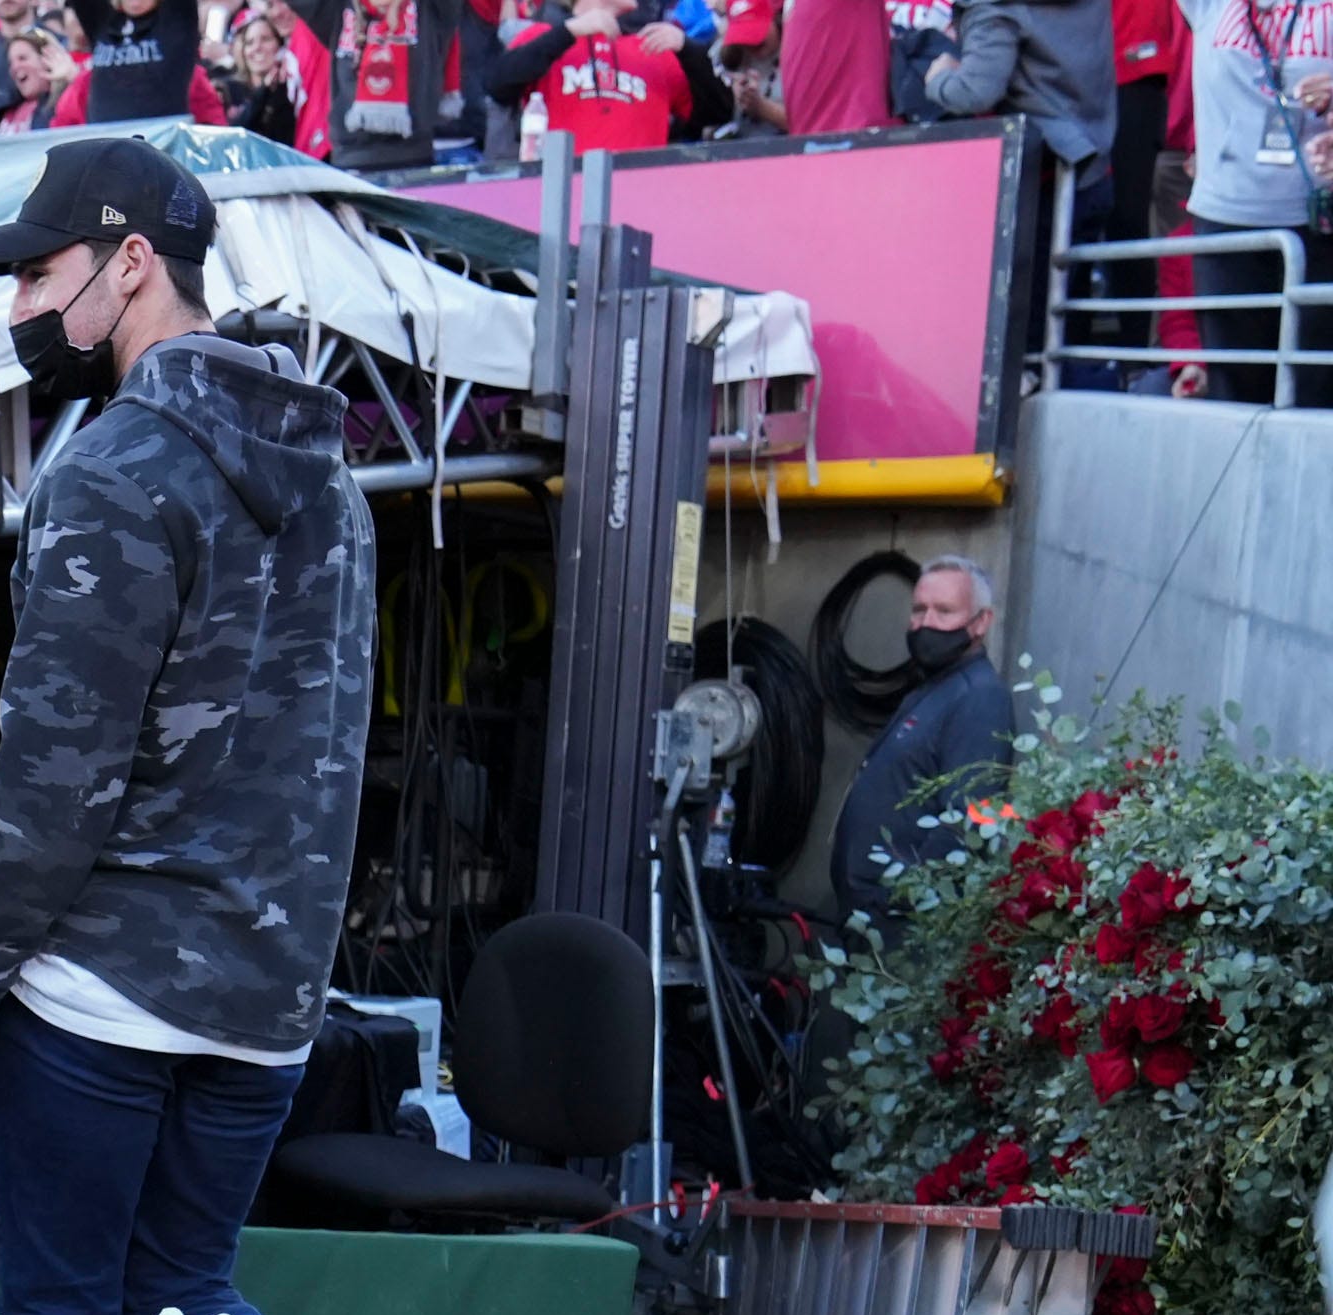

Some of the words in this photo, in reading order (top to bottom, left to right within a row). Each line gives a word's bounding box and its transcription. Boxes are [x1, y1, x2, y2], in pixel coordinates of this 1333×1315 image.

[620, 337, 640, 406] TOWER
[616, 409, 633, 472] SUPER
[608, 474, 629, 529] Genie
